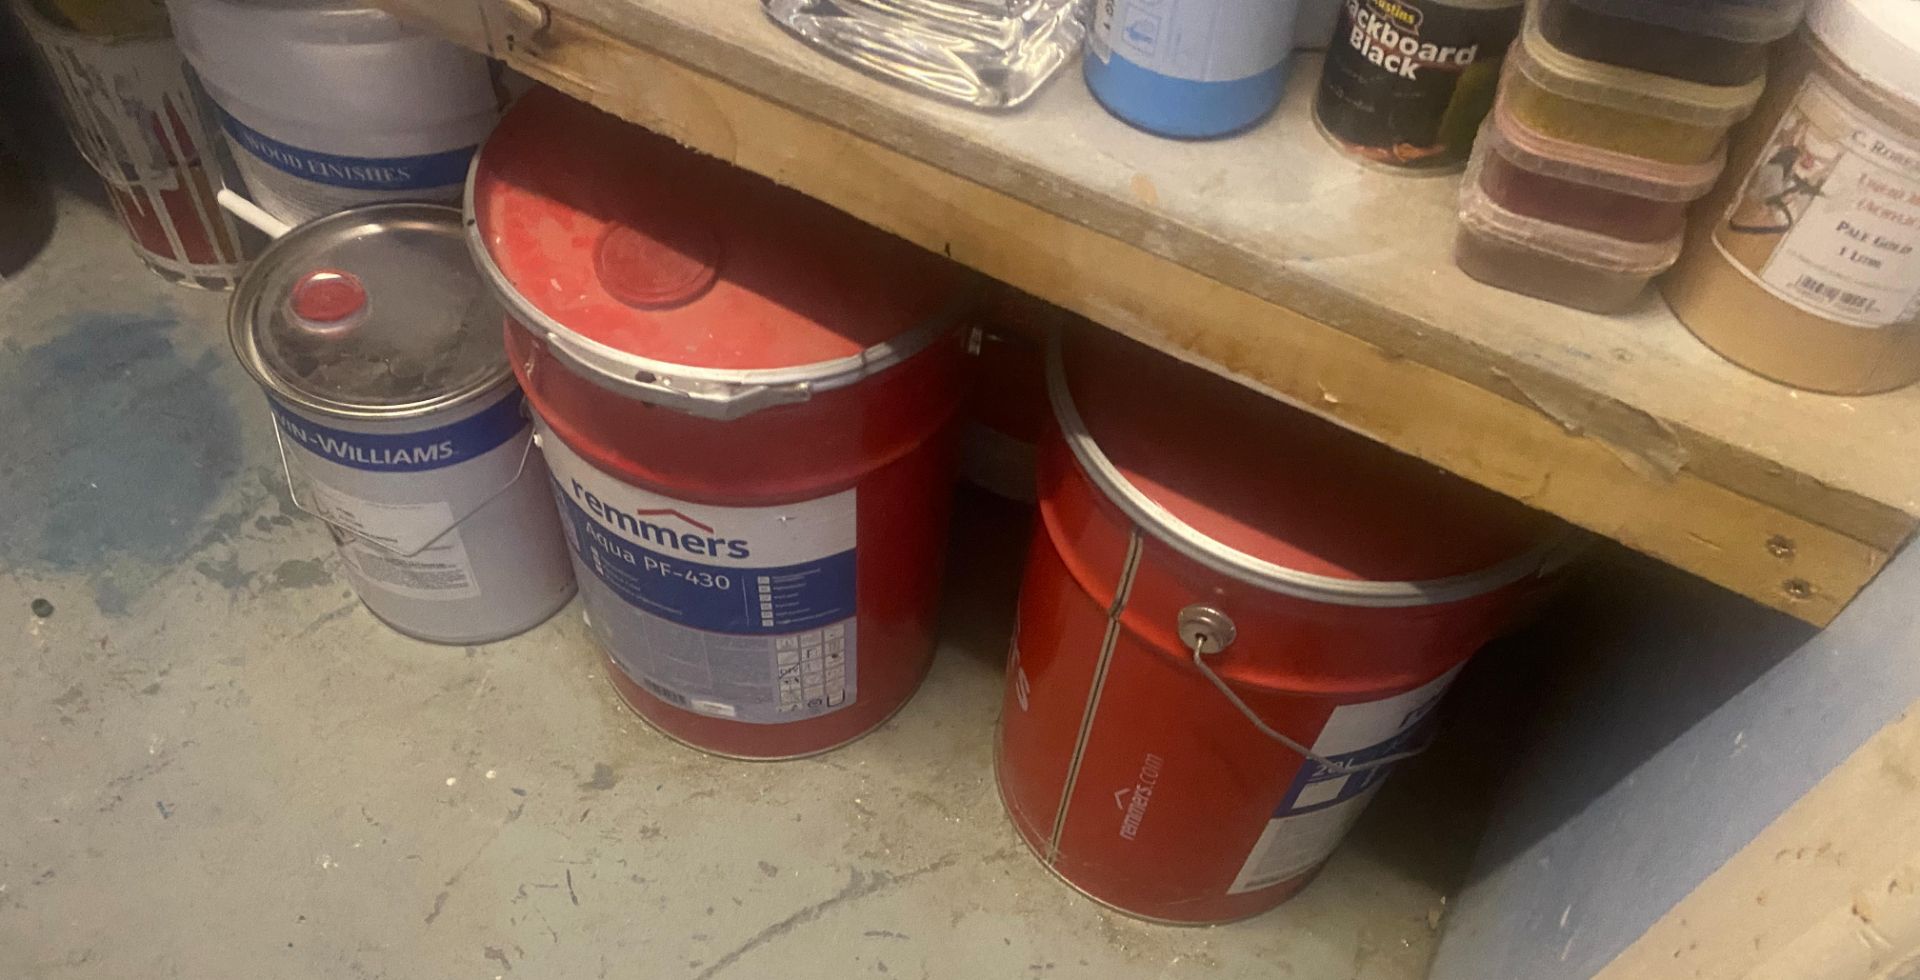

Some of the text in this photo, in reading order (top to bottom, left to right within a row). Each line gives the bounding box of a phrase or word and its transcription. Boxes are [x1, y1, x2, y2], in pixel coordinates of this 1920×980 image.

[1350, 25, 1420, 80] Black
[306, 159, 411, 183] FINISHES
[571, 477, 750, 559] remmers
[586, 521, 636, 566] Aqua
[644, 555, 731, 591] PF-430
[1119, 753, 1164, 841] remmers.com
